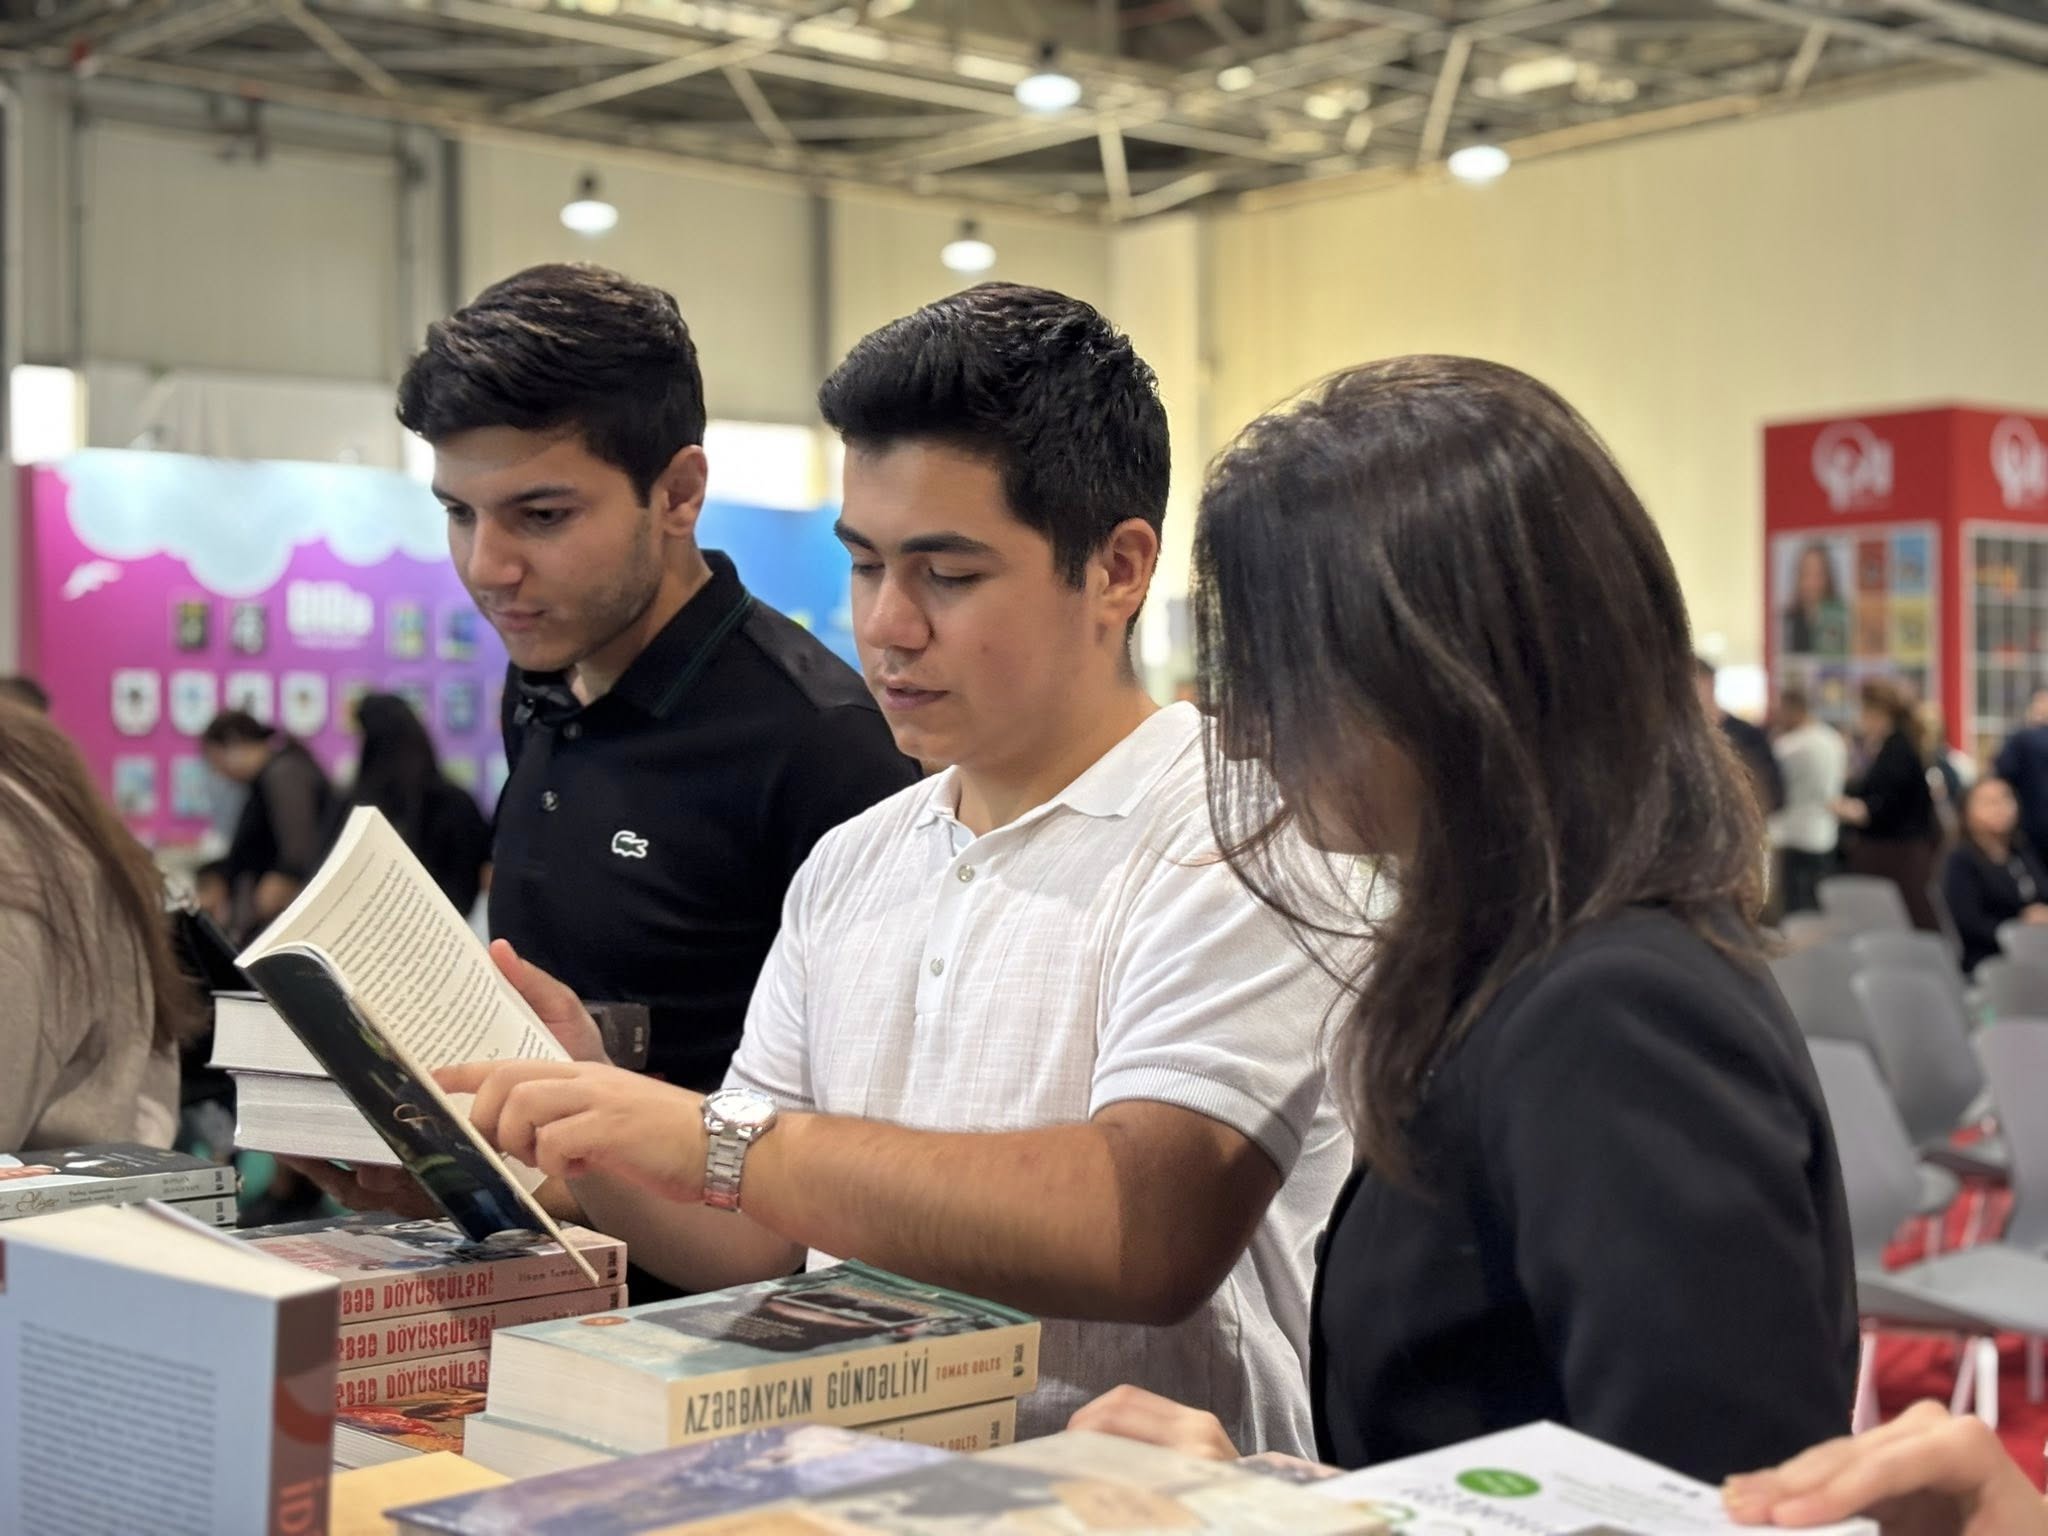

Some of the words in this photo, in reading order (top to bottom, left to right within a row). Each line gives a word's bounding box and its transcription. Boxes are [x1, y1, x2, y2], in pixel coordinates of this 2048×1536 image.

[387, 1360, 488, 1400] DÖYÜŞÇÜLƏR
[684, 1376, 813, 1435] AZƏRBAYCAN
[826, 1347, 930, 1409] GÜNDƏLİYİ
[935, 1361, 968, 1382] TOMAS
